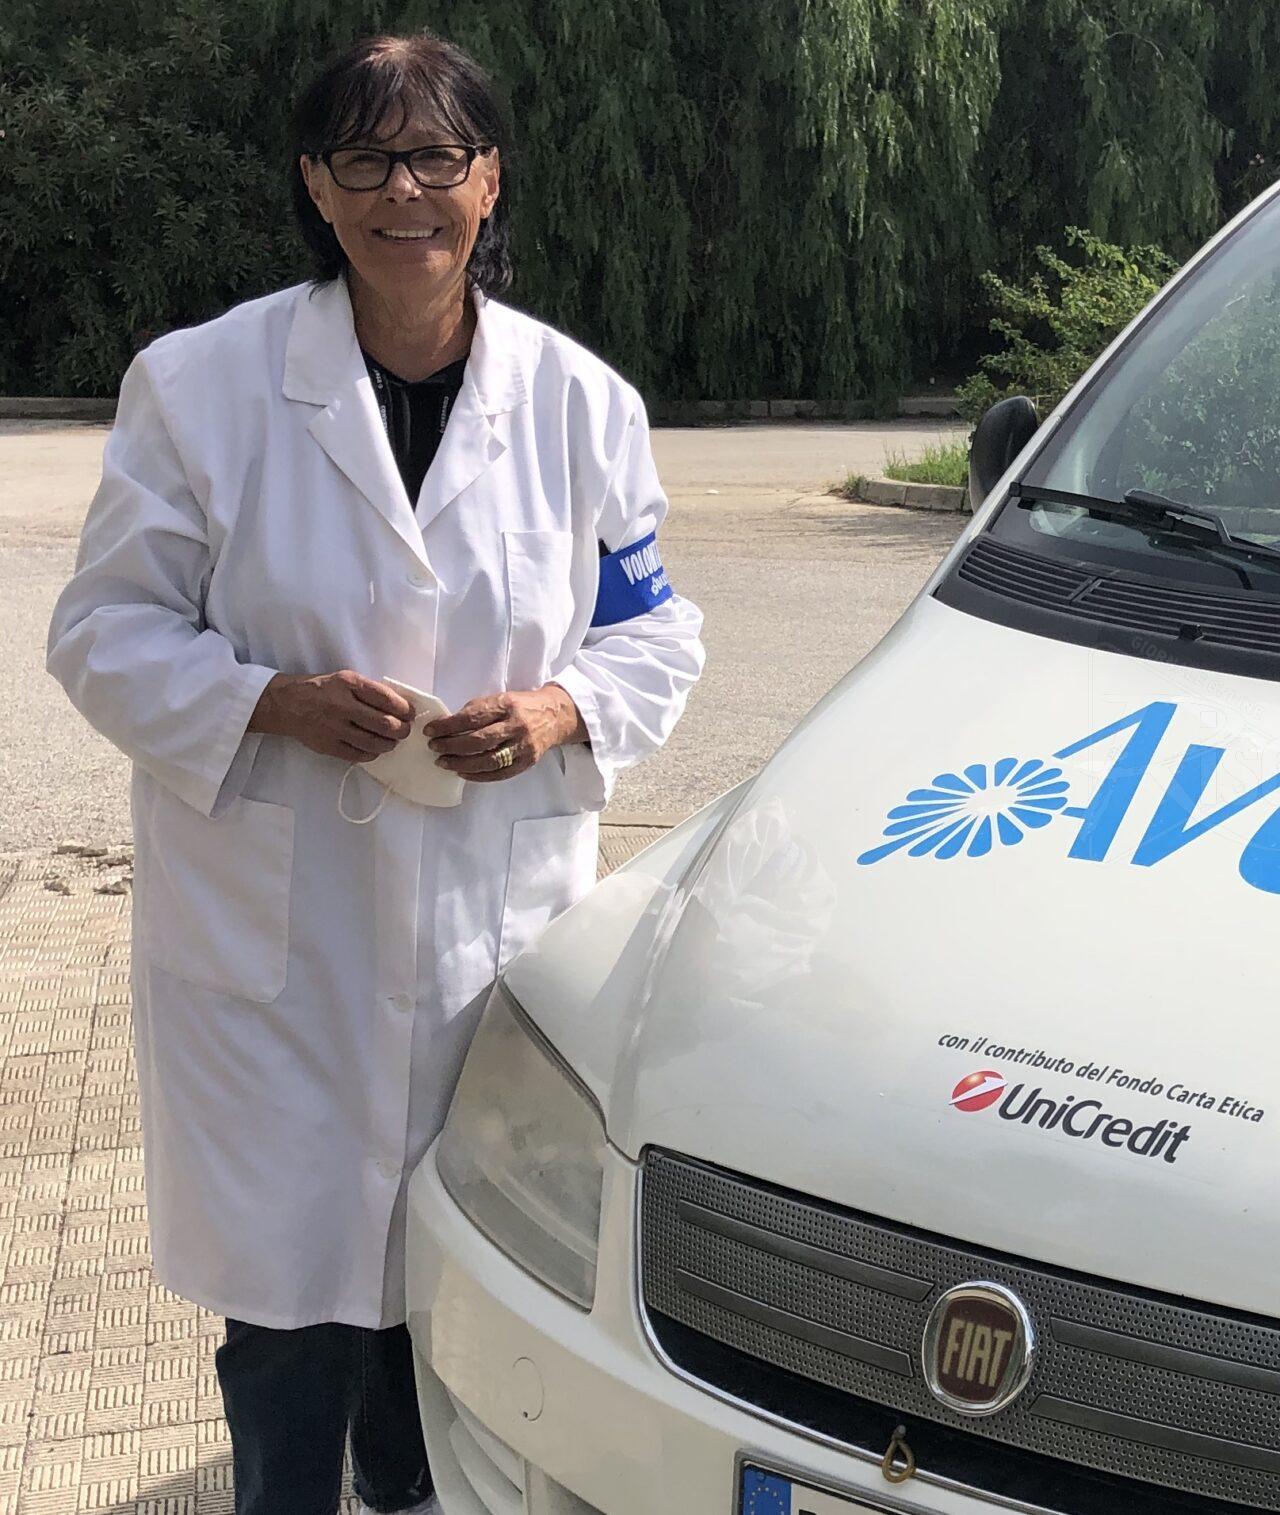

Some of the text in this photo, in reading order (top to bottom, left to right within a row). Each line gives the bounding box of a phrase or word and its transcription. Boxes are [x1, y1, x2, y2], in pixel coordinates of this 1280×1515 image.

[937, 1034, 1265, 1123] con il contributo del Fondo Carta Etica
[998, 1083, 1192, 1164] UniCredit
[942, 1319, 1013, 1388] FIAT
